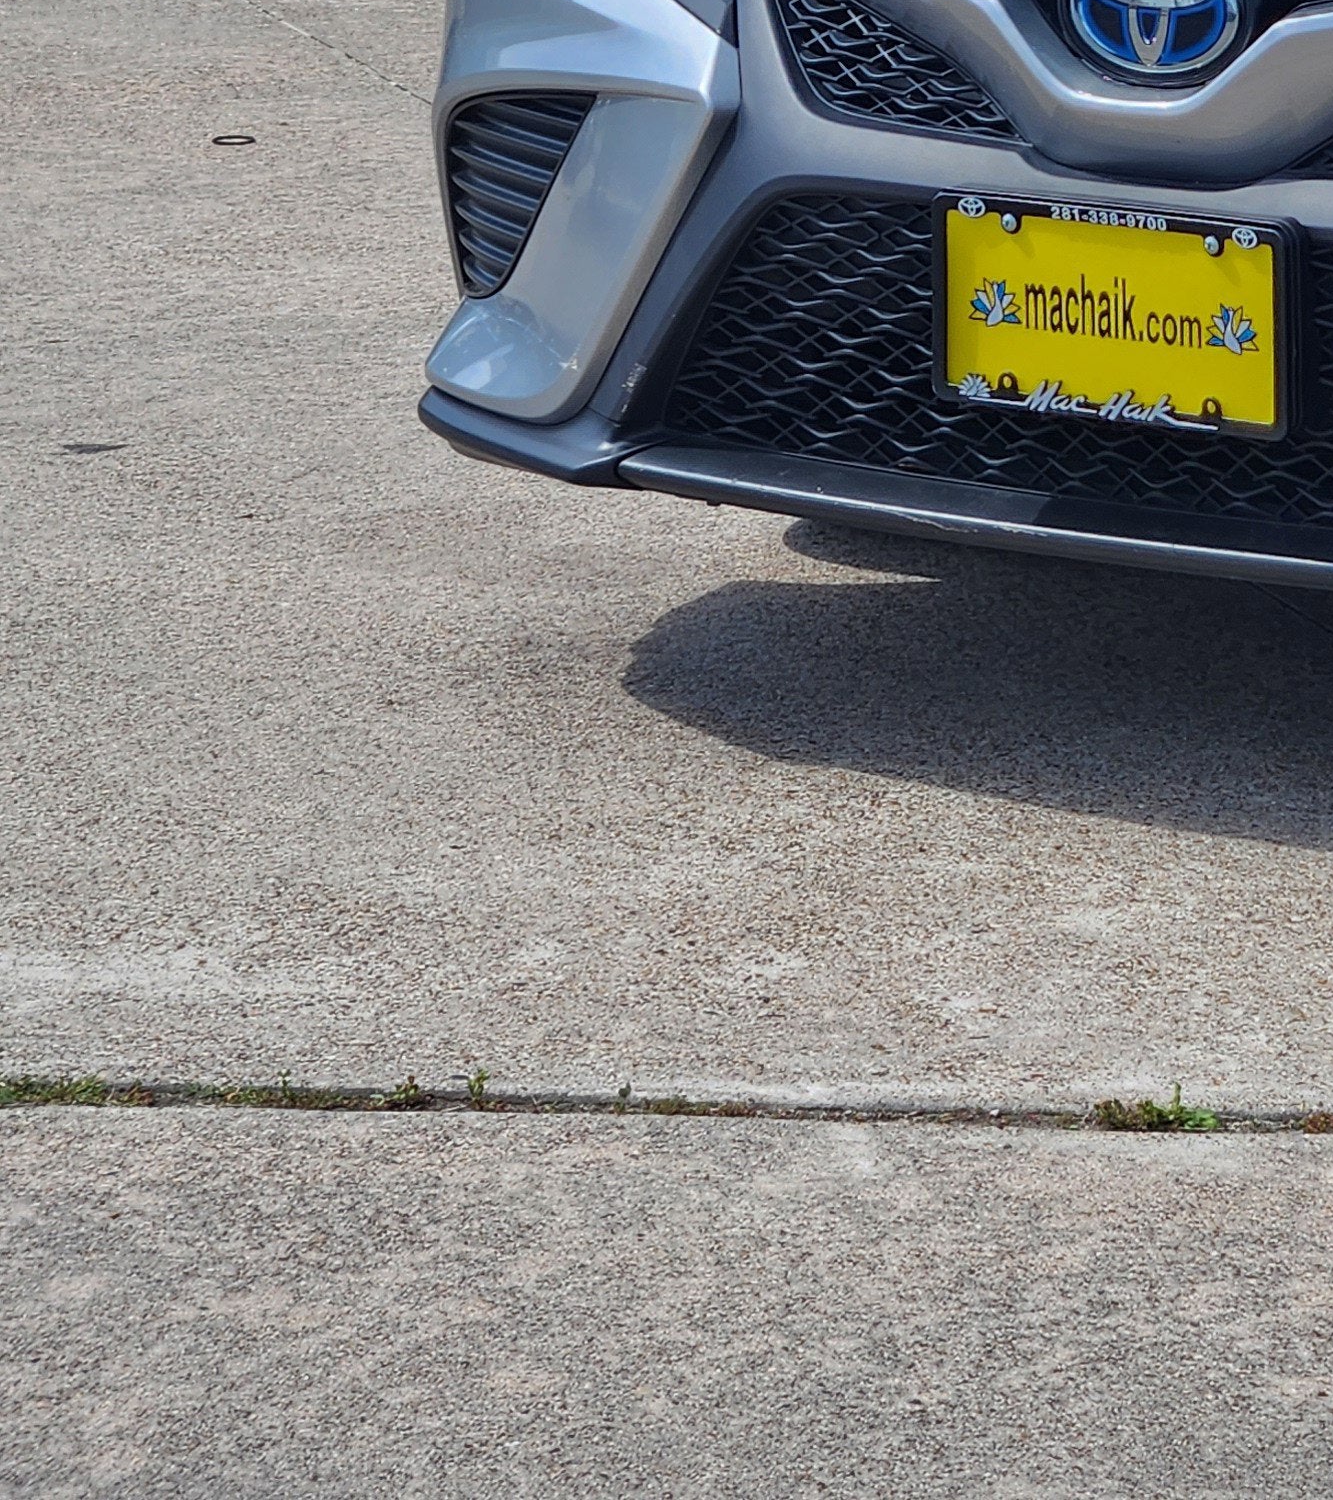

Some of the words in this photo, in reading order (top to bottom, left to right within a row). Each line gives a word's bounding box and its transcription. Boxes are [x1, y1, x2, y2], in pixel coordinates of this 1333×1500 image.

[1050, 205, 1167, 231] 281-338-9700
[1024, 273, 1203, 349] machaik.com
[1025, 379, 1096, 412] Mac
[1099, 389, 1188, 425] Haik
